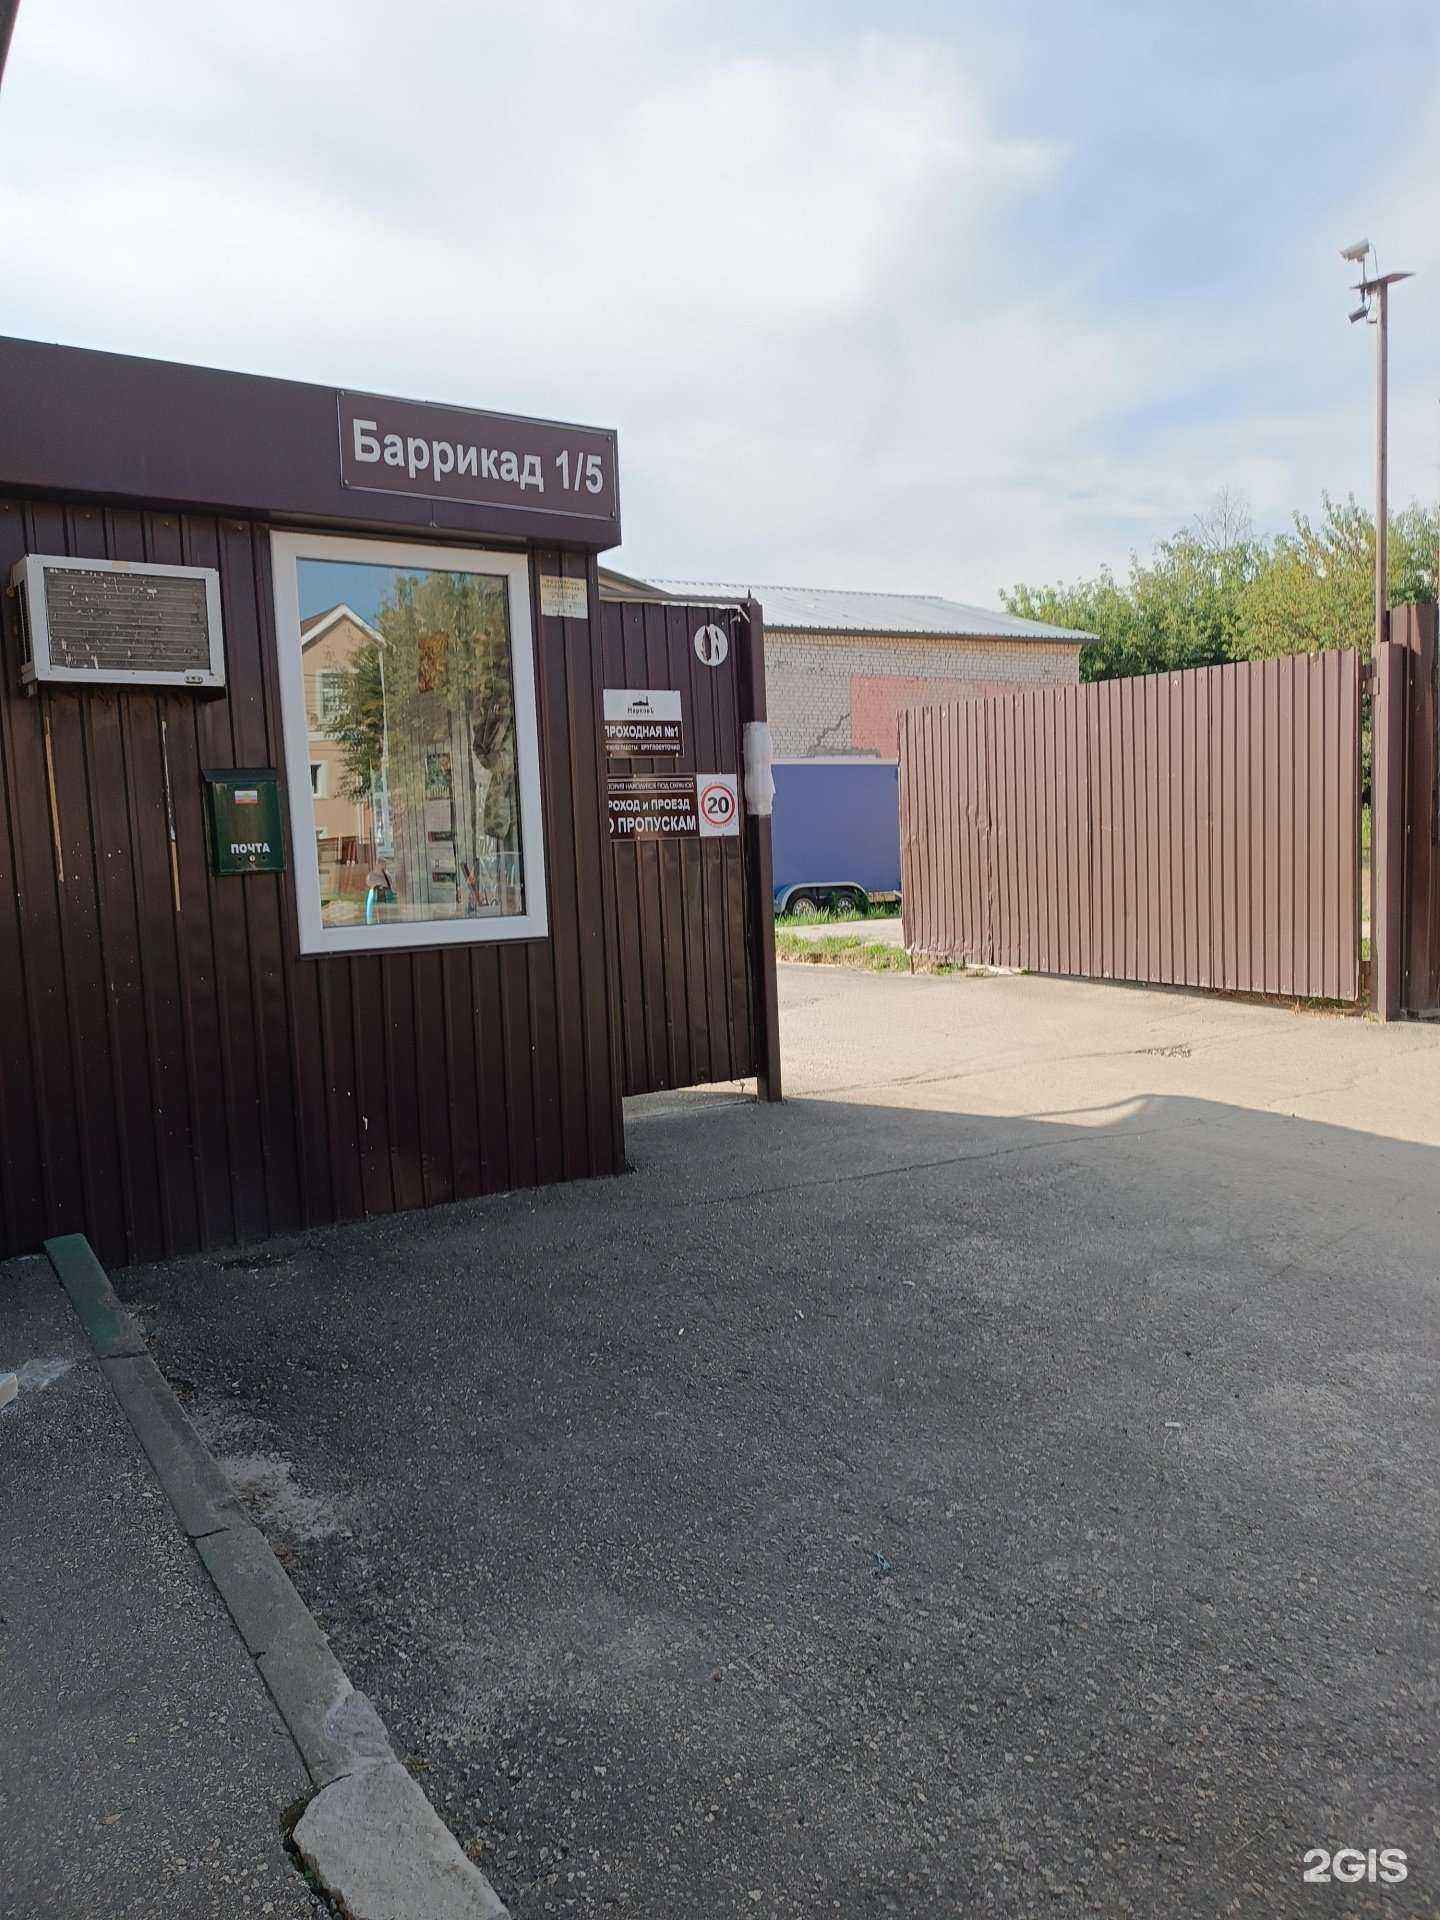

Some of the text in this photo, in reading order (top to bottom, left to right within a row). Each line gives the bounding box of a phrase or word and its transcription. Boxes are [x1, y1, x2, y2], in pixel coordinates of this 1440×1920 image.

[353, 418, 604, 494] Баррикад 1/5
[664, 725, 679, 738] №1
[651, 798, 691, 811] ПРОЕЗД
[708, 797, 730, 814] 20
[618, 815, 697, 833] ПРОПУСКАМ
[230, 843, 271, 854] ПОЧТА
